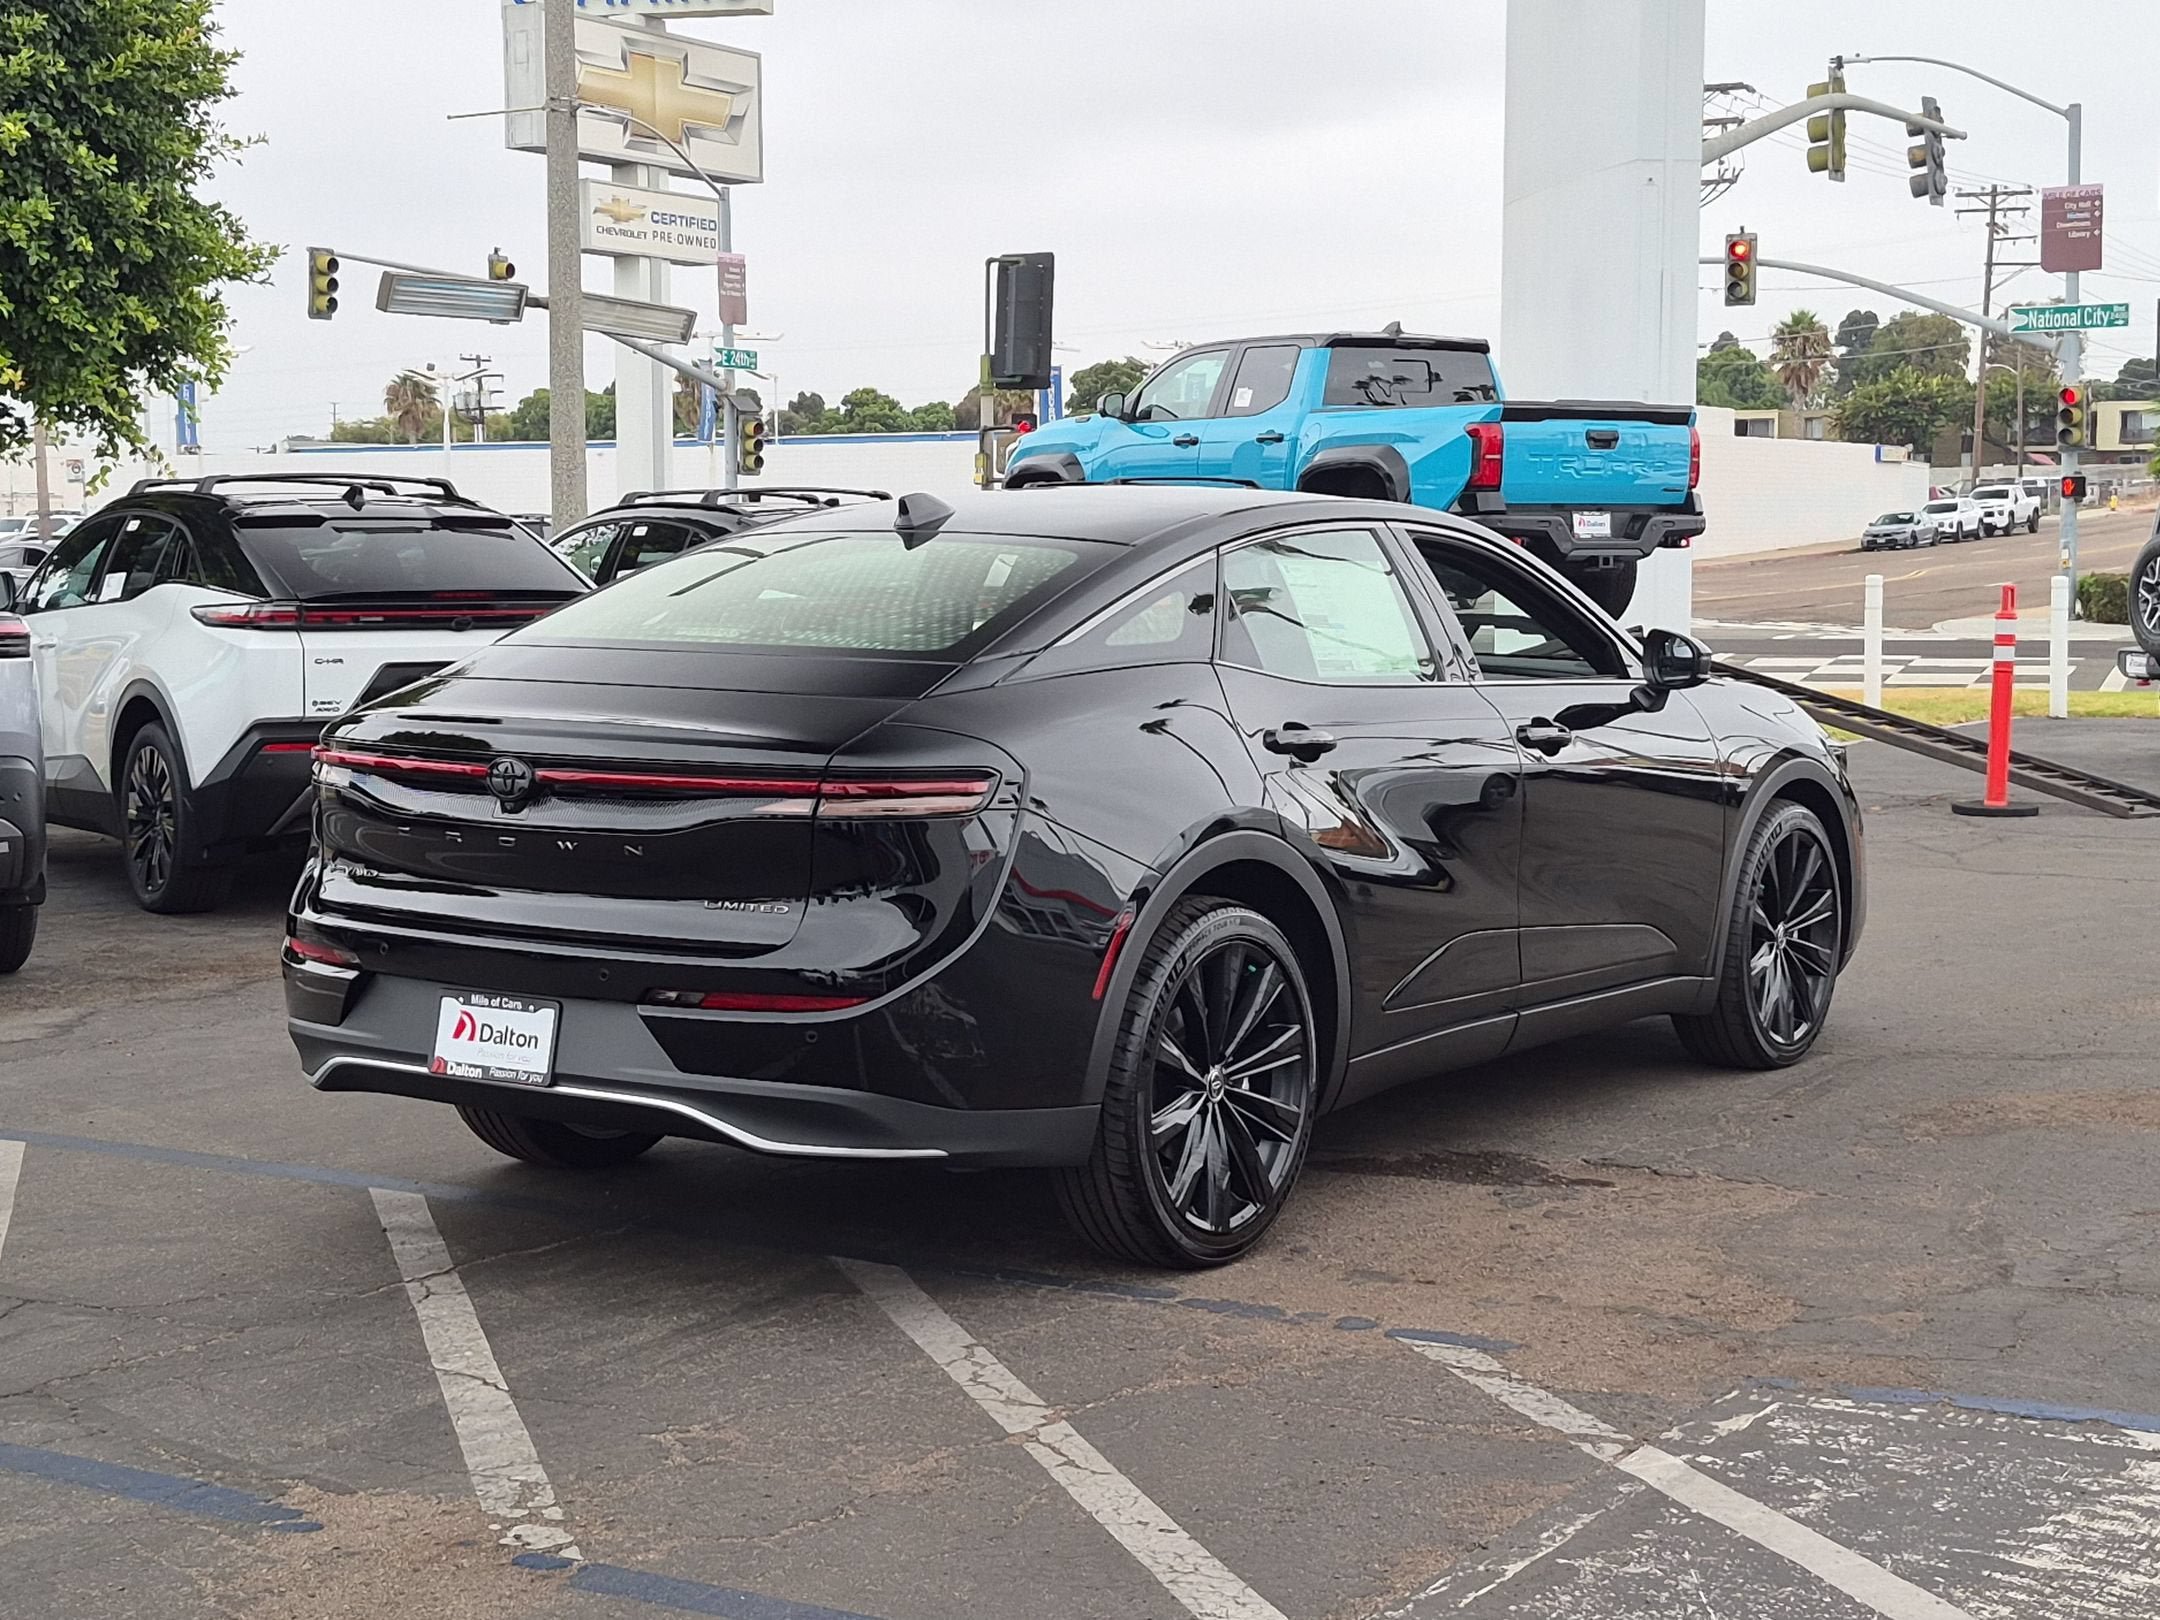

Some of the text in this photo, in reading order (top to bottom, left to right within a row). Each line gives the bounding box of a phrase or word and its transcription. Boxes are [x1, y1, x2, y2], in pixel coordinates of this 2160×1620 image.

[2064, 202, 2077, 210] City
[650, 211, 718, 232] CERTIFIED
[596, 225, 717, 249] CHEVROLET PRE-OWNED
[2028, 307, 2110, 329] National City
[722, 350, 730, 366] E
[730, 351, 750, 367] 24th
[1528, 453, 1606, 479] TRD
[704, 899, 790, 914] LIMITED
[470, 994, 522, 1010] Mile of Cars
[479, 1022, 539, 1049] Dalton
[446, 1060, 544, 1083] Dalton Passion for you
